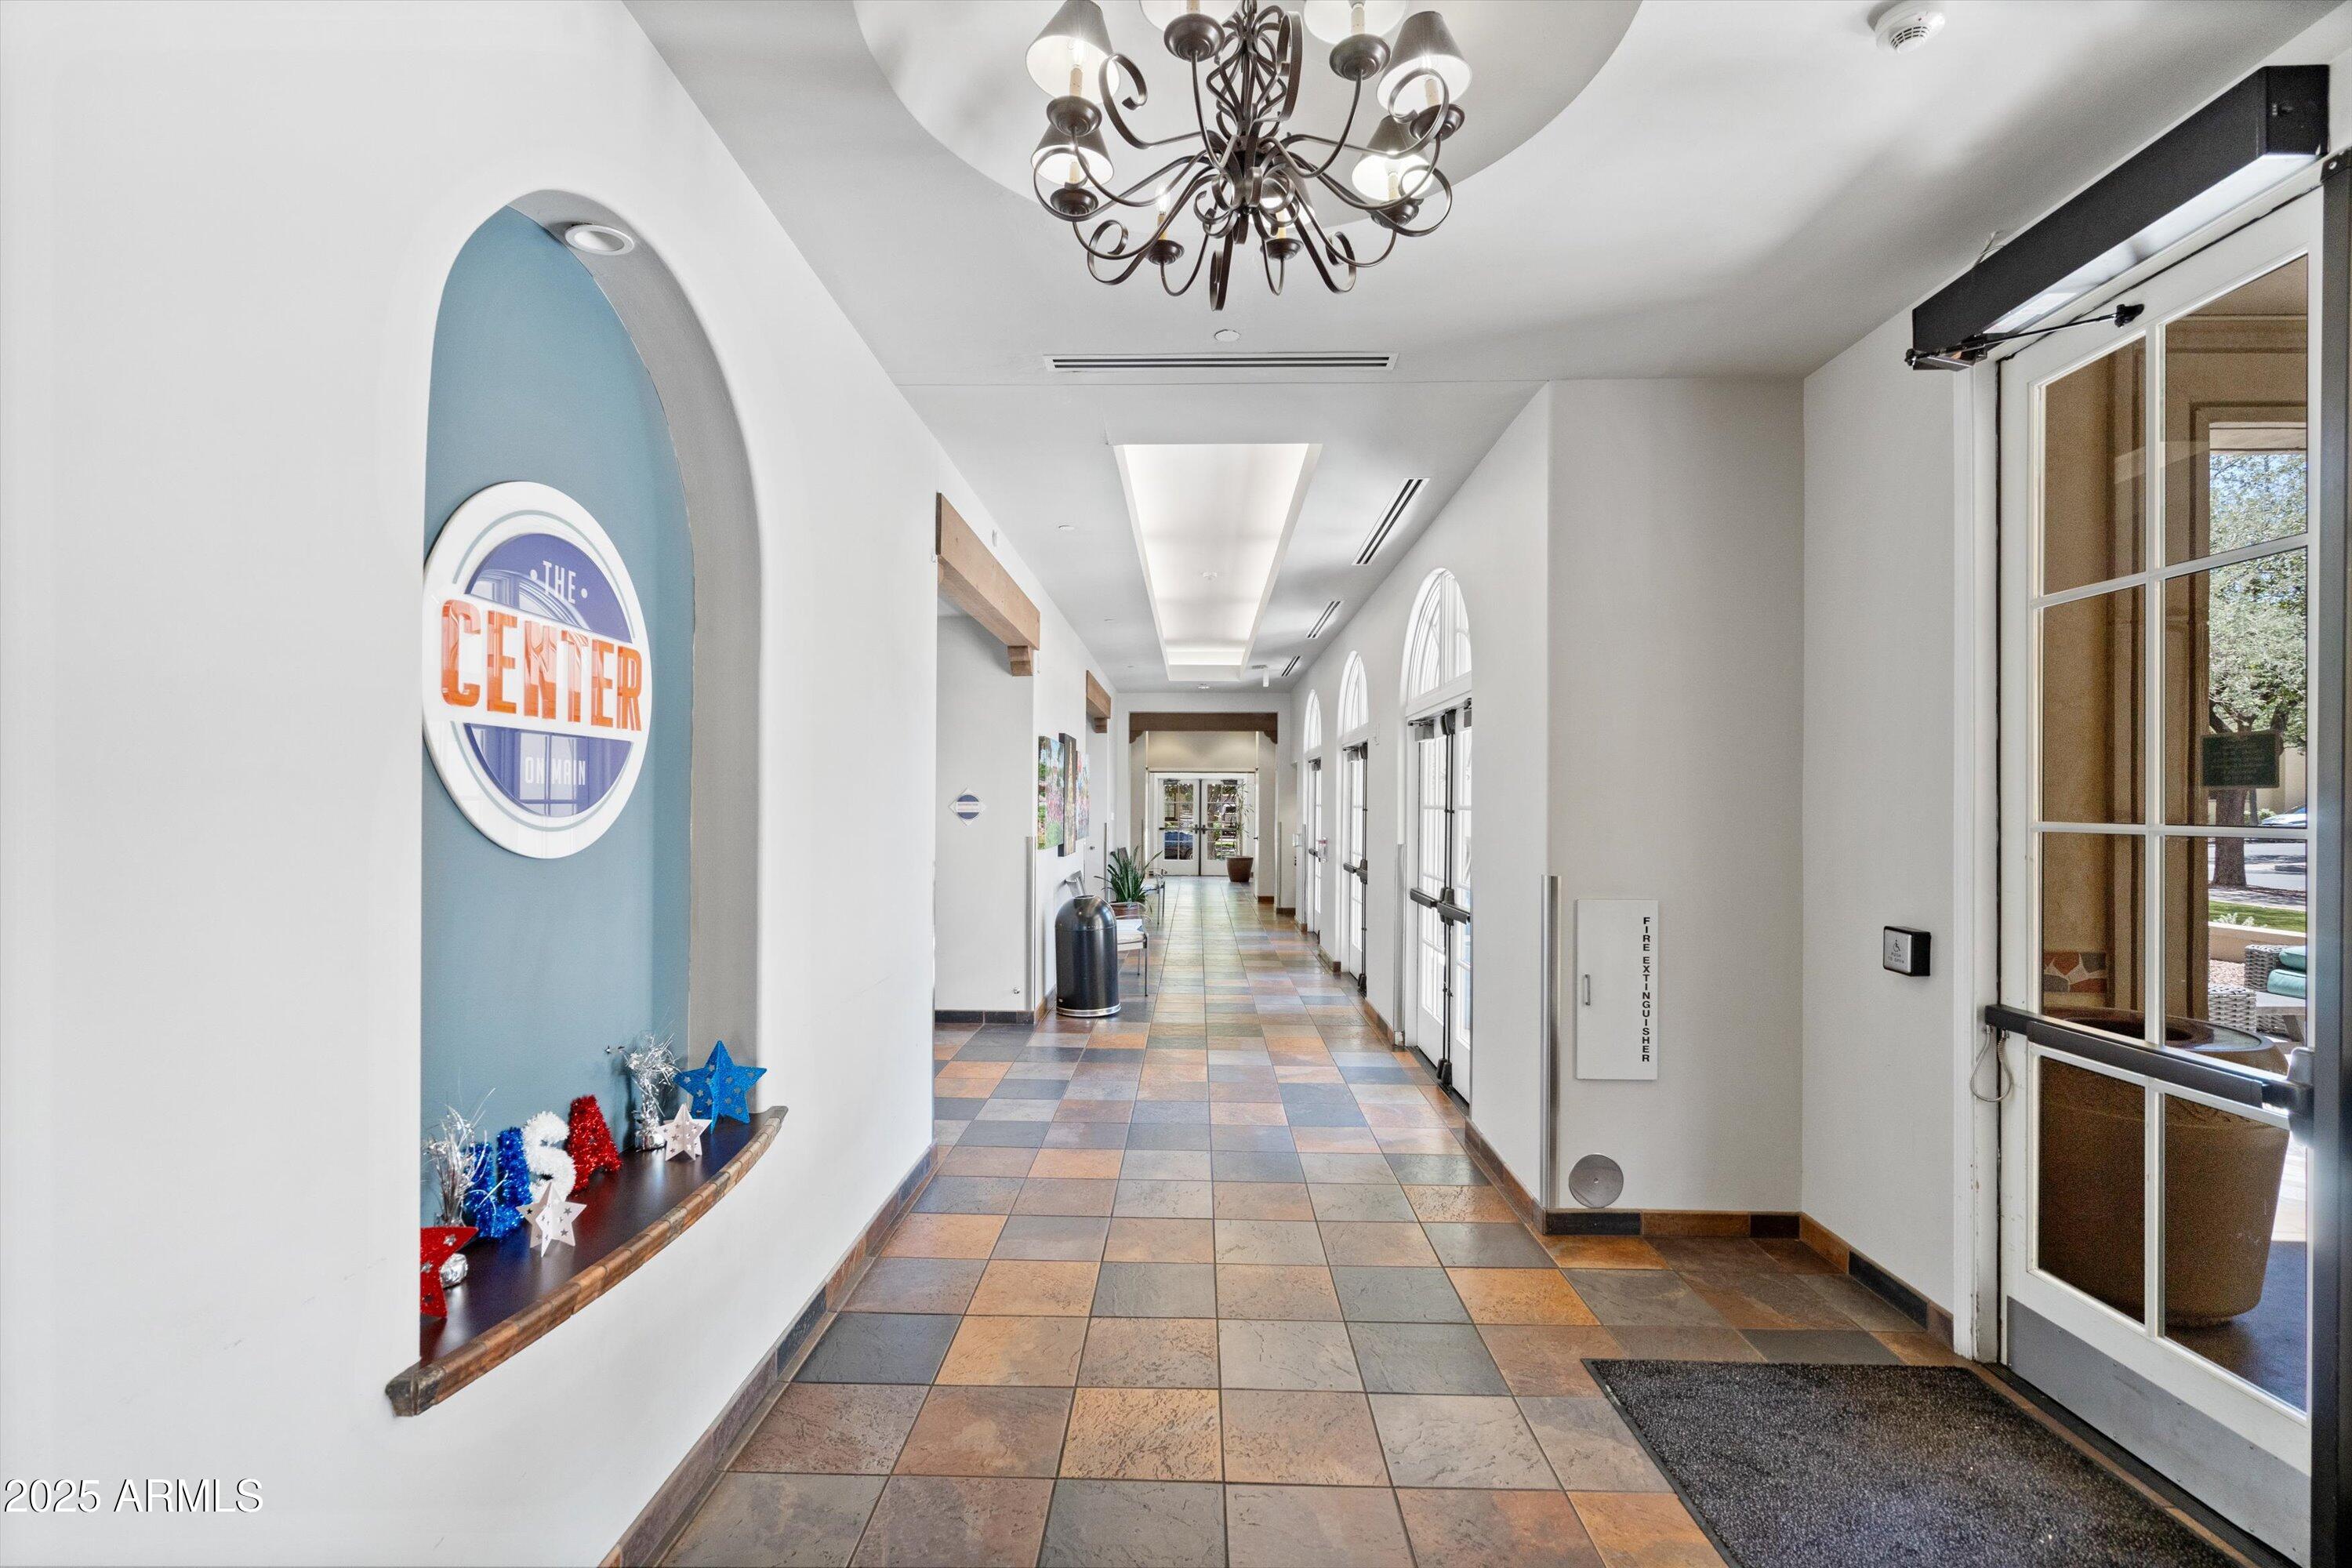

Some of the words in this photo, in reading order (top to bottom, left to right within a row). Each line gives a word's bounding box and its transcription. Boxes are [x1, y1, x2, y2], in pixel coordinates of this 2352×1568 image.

[543, 560, 576, 604] THE
[441, 599, 642, 731] CENTER
[524, 757, 546, 784] ON
[550, 757, 586, 786] MAIN
[1642, 917, 1651, 952] FIRE
[1642, 956, 1651, 1062] EXTINGUISHER
